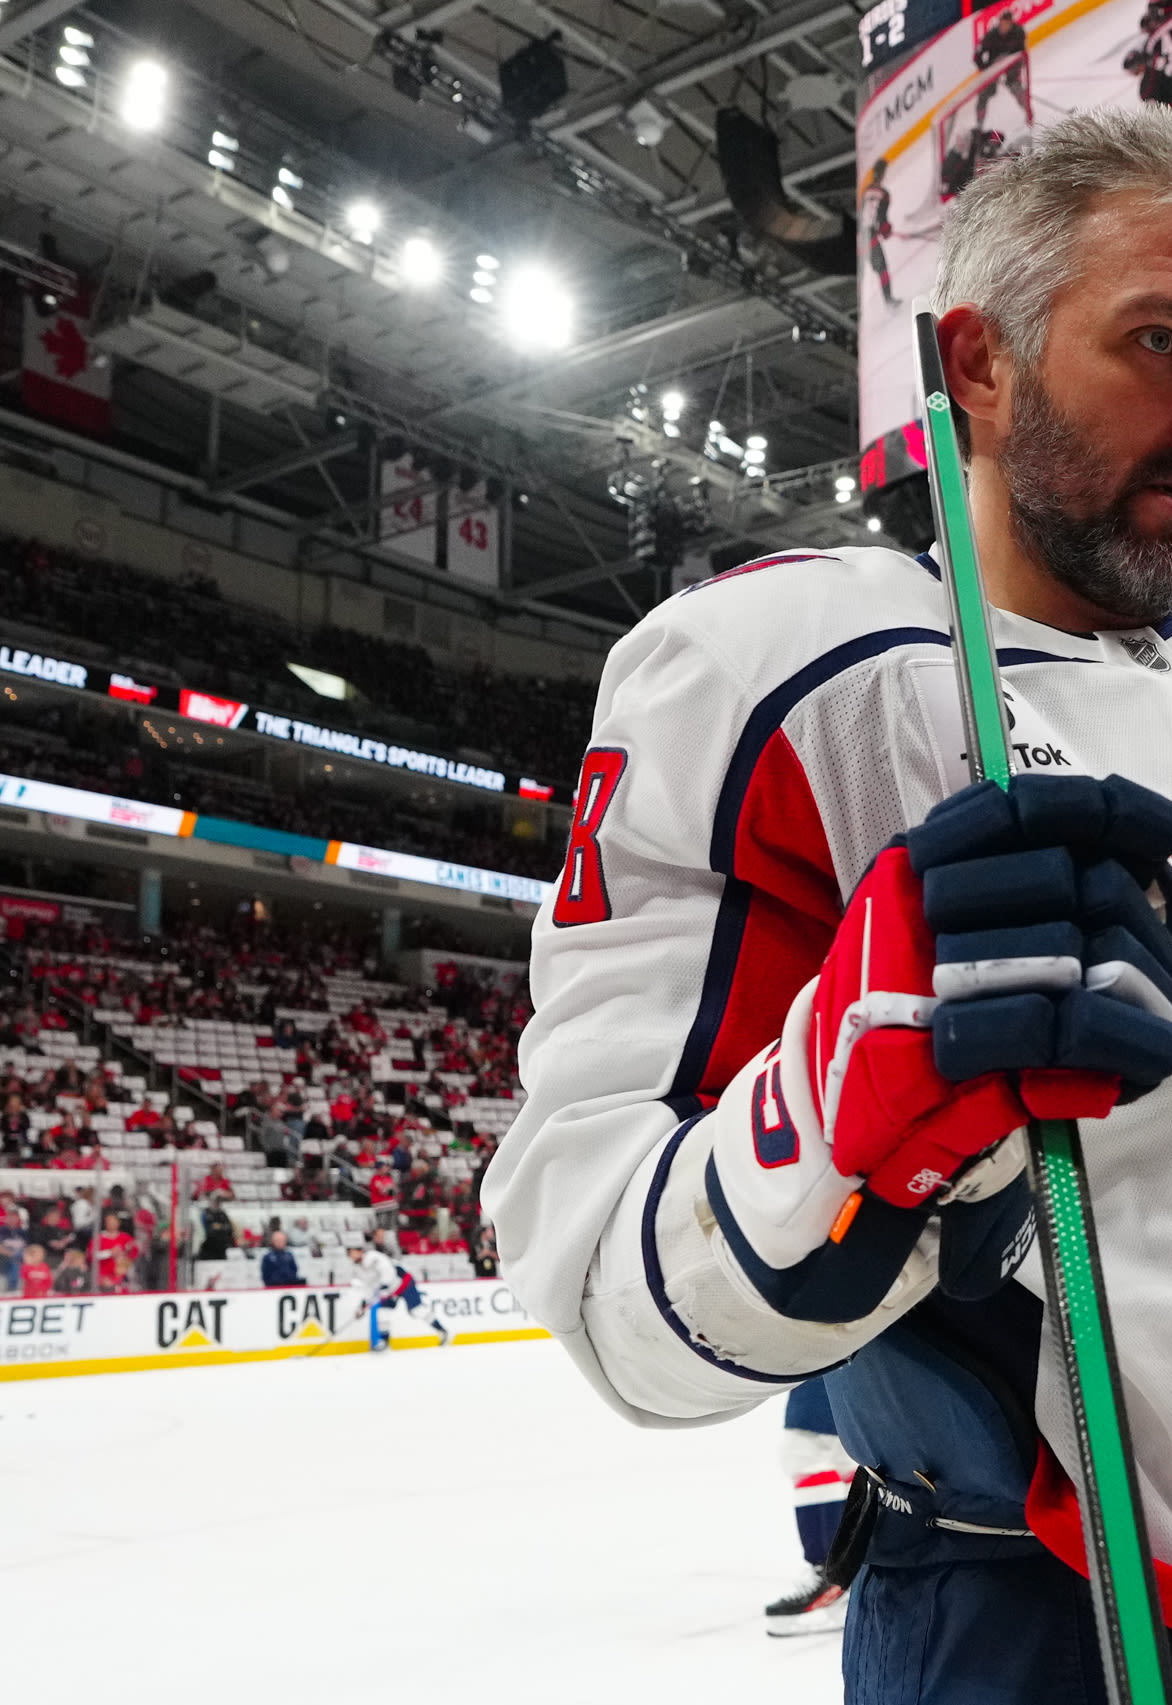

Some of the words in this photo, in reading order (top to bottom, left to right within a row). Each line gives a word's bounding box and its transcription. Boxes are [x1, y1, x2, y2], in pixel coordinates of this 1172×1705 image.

[459, 516, 488, 550] 43
[0, 647, 88, 689] LEADER
[255, 711, 292, 740] THE
[293, 720, 387, 763] TRIANGLE'S
[387, 746, 448, 778] SPORTS
[448, 760, 506, 792] LEADER
[552, 746, 628, 929] 8
[0, 1301, 94, 1336] BET
[157, 1299, 228, 1348] CAT
[278, 1293, 341, 1339] CAT
[420, 1290, 483, 1316] reat
